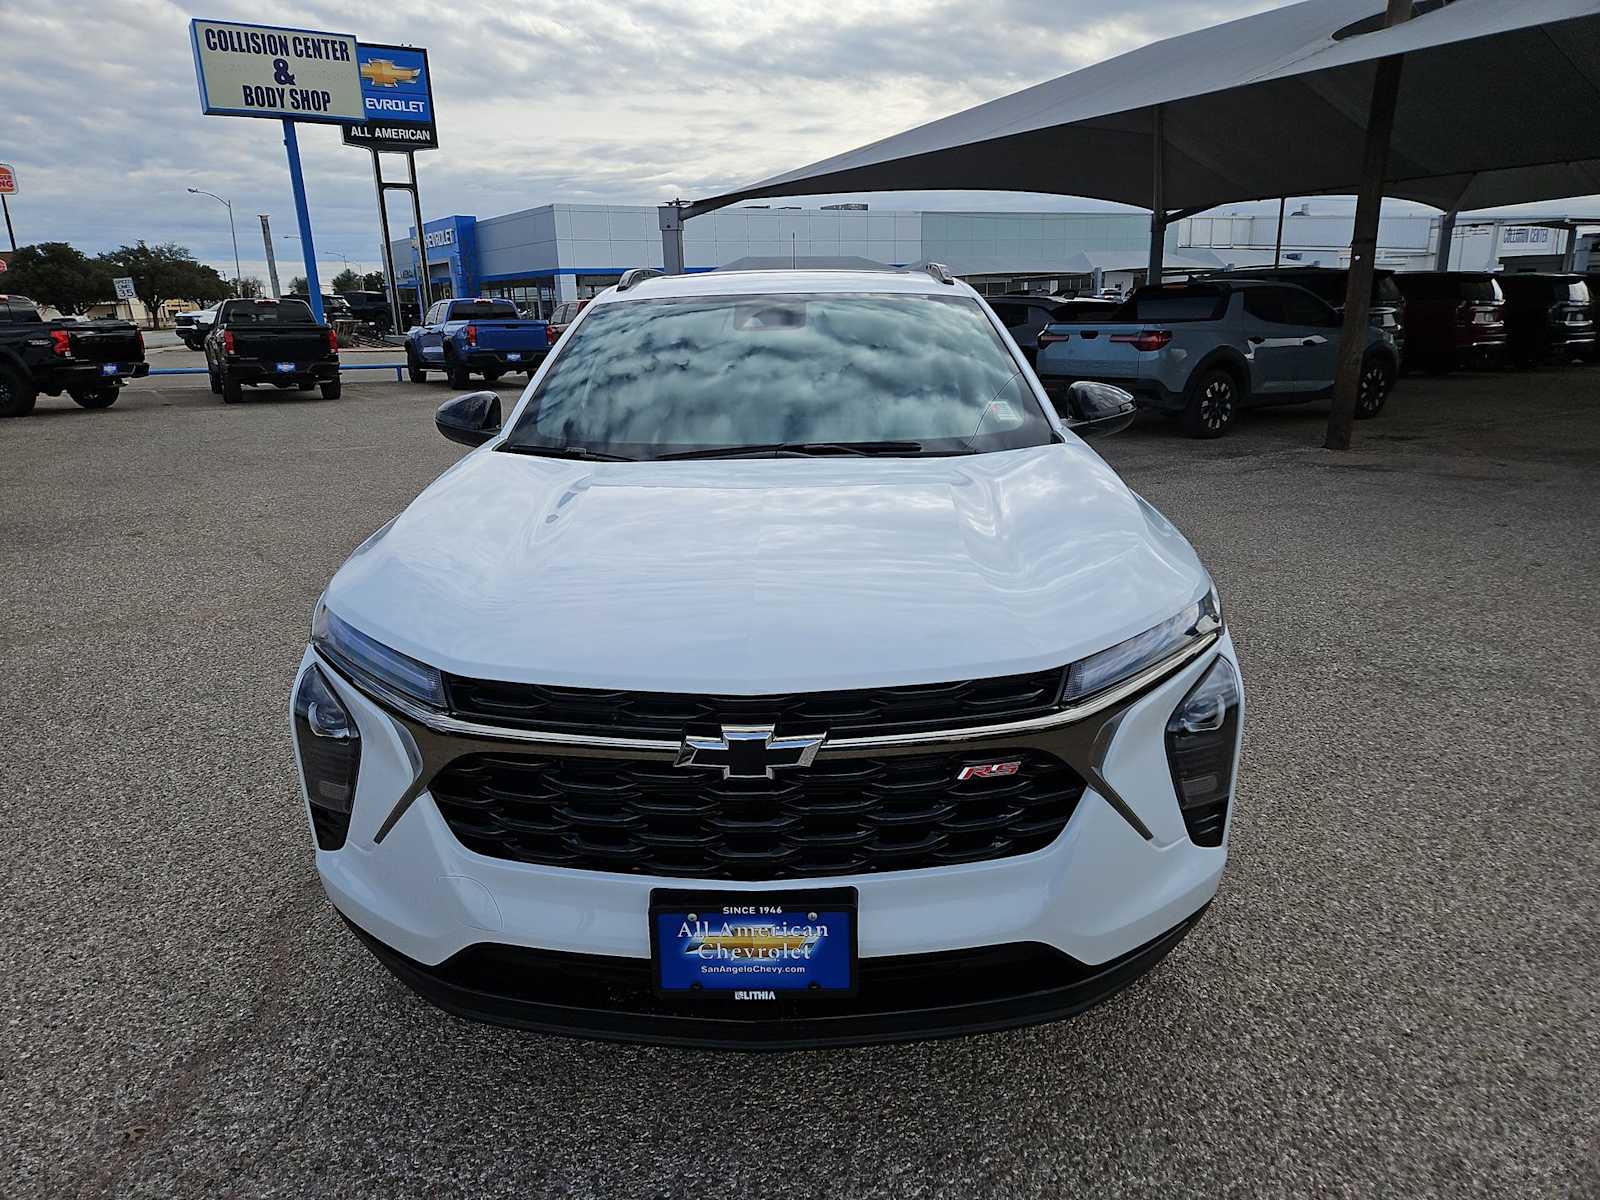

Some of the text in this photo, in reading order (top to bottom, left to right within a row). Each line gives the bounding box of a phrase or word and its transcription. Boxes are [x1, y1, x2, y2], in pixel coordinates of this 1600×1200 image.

[205, 28, 350, 62] COLLISION CENTER
[272, 58, 296, 86] &
[243, 85, 331, 112] BODY SHOP
[365, 97, 424, 113] EVROLET
[351, 125, 431, 140] ALL AMERICAN
[424, 228, 454, 249] HEVROLET
[118, 289, 134, 297] 35
[956, 760, 1022, 781] RS
[722, 906, 783, 915] SINCE 1946
[677, 921, 829, 937] All American
[698, 943, 812, 960] Chevrolet
[701, 965, 806, 975] SanAngeloChevy.com
[743, 990, 776, 1001] LITHIA
